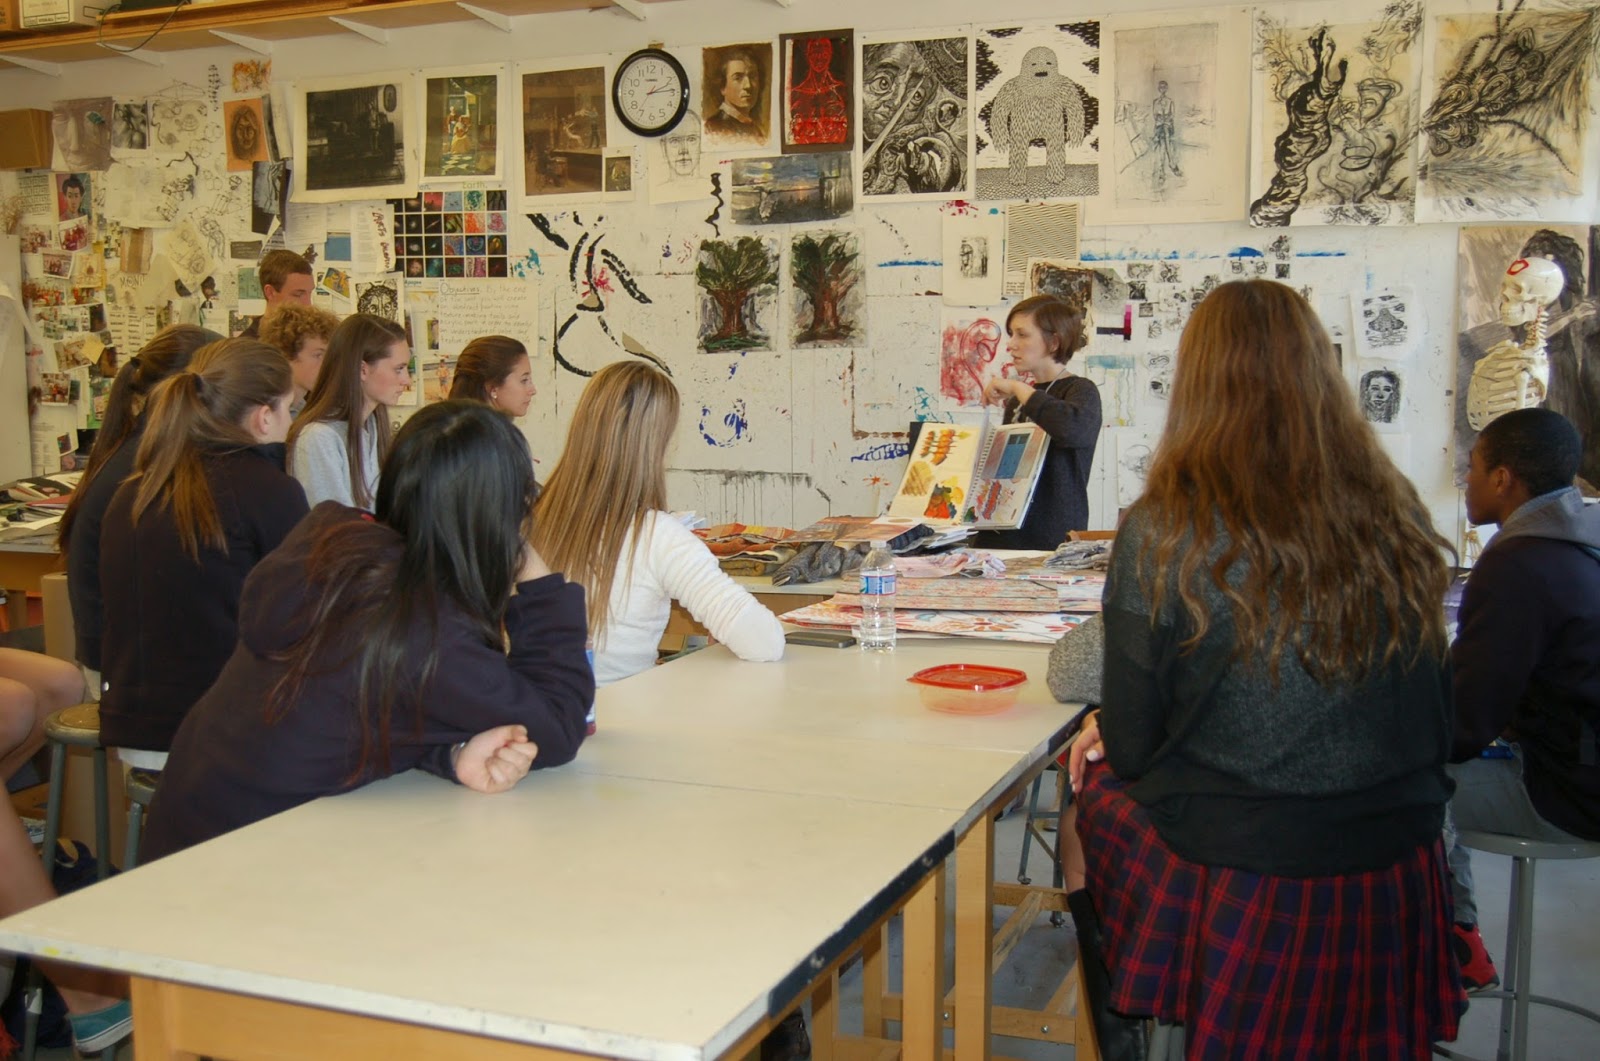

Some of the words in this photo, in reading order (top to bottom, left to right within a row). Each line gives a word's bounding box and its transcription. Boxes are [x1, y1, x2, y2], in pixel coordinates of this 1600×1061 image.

[646, 64, 656, 74] 12
[630, 78, 640, 87] 10
[666, 76, 673, 85] 2
[628, 89, 635, 98] 9
[670, 88, 676, 97] 3
[630, 100, 638, 110] 8
[667, 100, 673, 108] 4
[638, 109, 645, 118] 7
[648, 112, 655, 121] 6
[658, 108, 666, 118] 5
